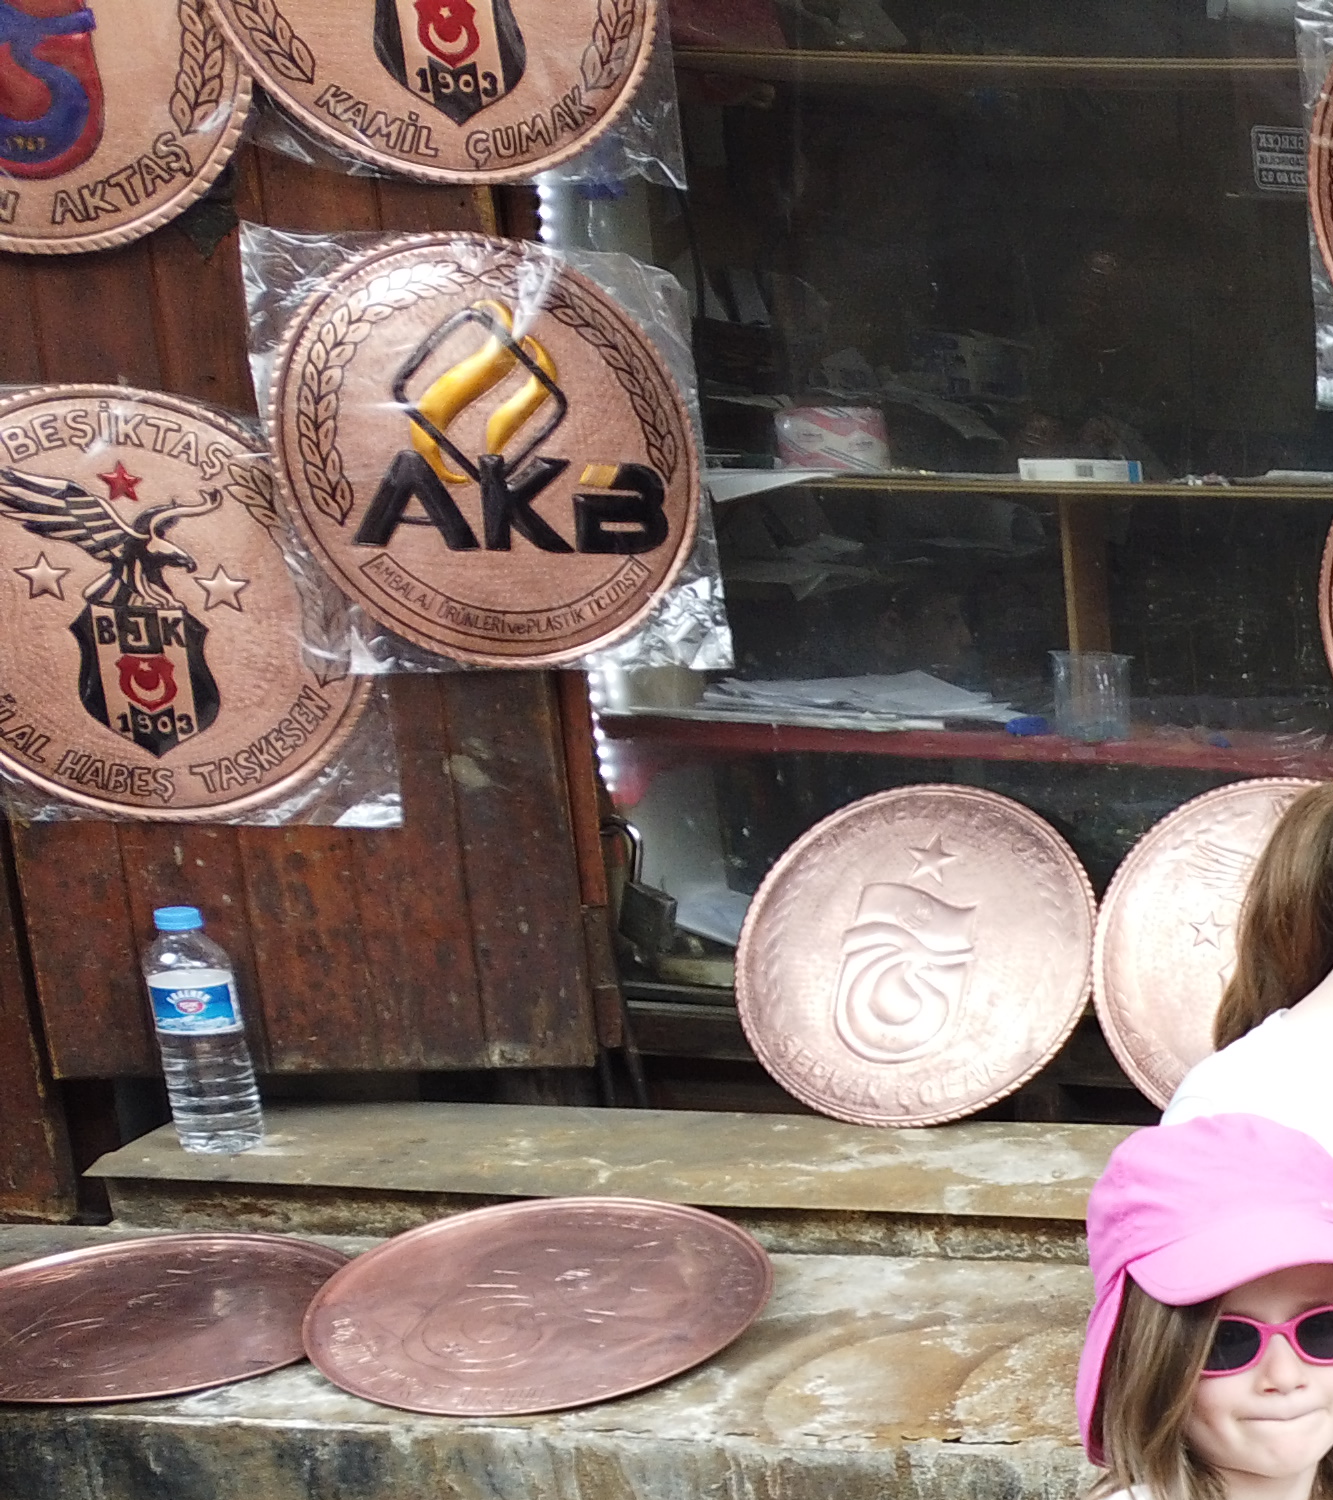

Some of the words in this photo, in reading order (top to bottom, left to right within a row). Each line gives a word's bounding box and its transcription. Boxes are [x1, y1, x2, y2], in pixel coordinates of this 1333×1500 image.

[415, 66, 499, 98] 1903
[314, 83, 440, 159] KAMİL
[465, 84, 597, 170] ÇUMAK
[51, 131, 195, 225] AKTAŞ
[0, 400, 234, 482] BEŞİKTAŞ
[352, 448, 670, 554] AKB
[367, 558, 436, 611] AMBALAJ
[95, 614, 188, 648] BJK
[54, 749, 176, 803] HABEŞ
[190, 684, 333, 794] TAŞKESEN
[116, 713, 198, 734] 1903
